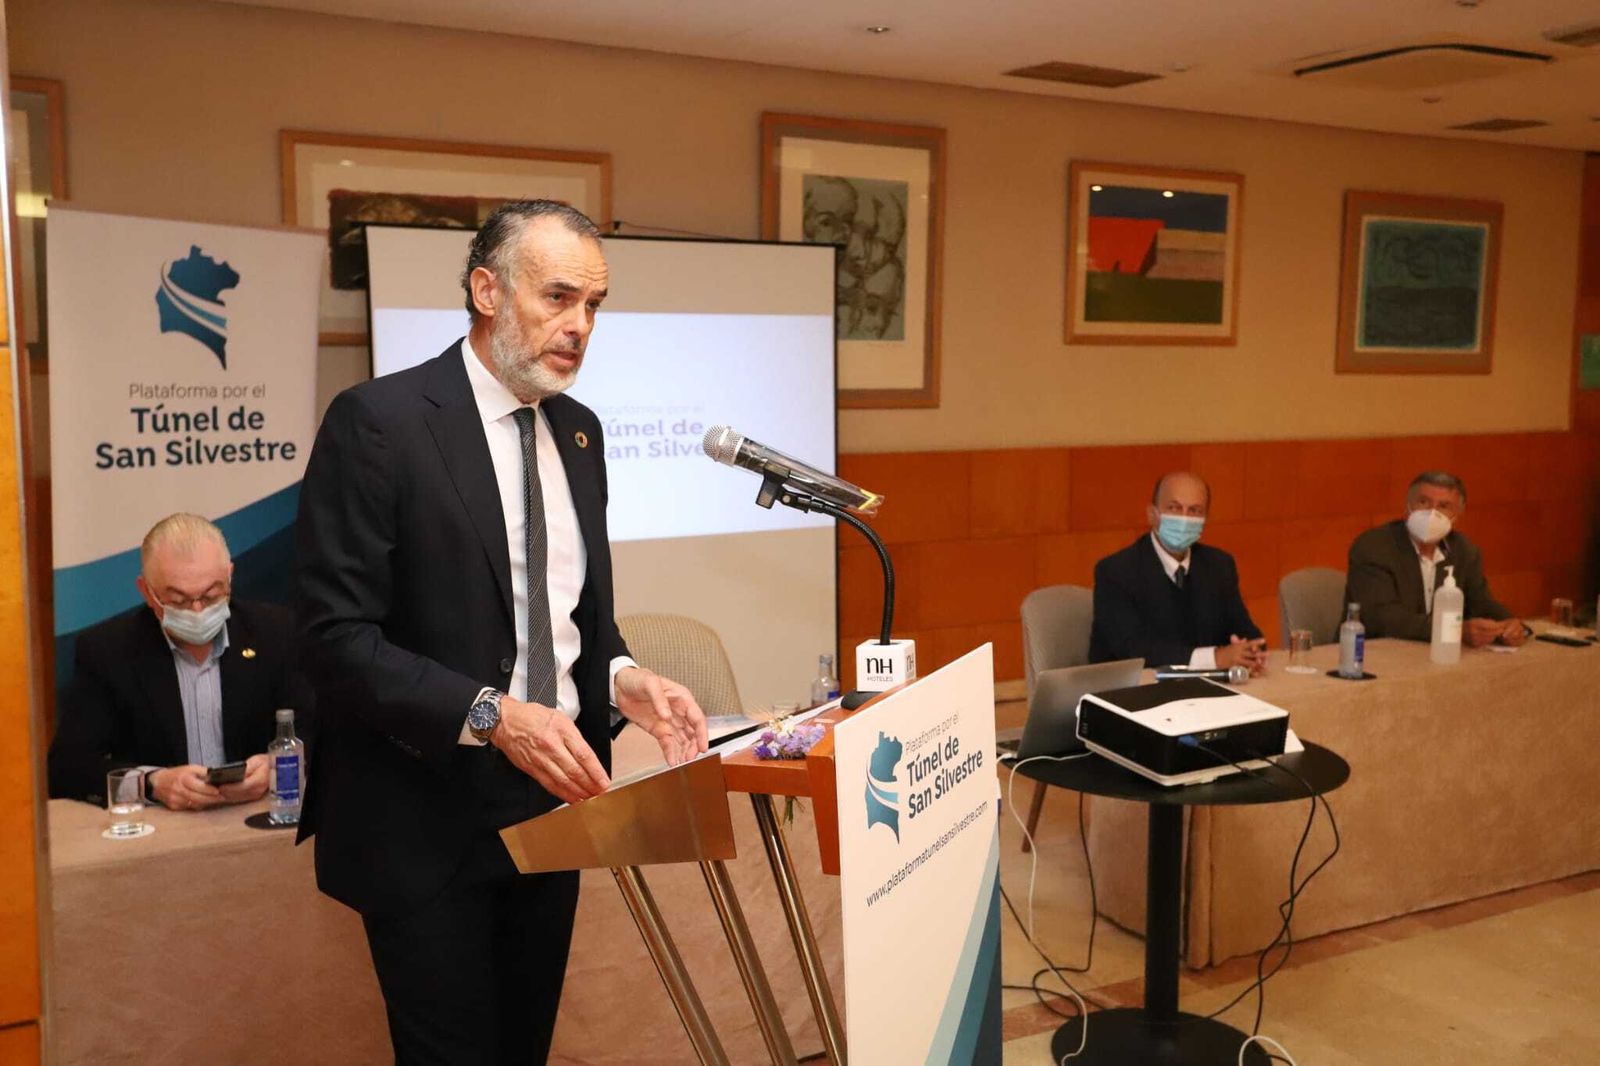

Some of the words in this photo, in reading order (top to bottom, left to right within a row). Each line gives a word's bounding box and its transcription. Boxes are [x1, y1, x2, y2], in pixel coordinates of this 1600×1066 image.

[128, 383, 218, 399] Plataforma
[222, 385, 248, 399] por
[251, 384, 266, 398] el
[130, 403, 219, 433] Túnel
[228, 405, 265, 431] de
[601, 418, 664, 437] únel
[671, 419, 703, 435] de
[95, 443, 156, 469] San
[166, 436, 297, 466] Silvestre
[606, 445, 640, 459] an
[904, 725, 941, 755] Plataforma
[941, 716, 953, 733] por
[906, 742, 942, 787] Túnel
[944, 735, 960, 761] de
[908, 786, 932, 819] San
[935, 750, 983, 800] Silvestre
[866, 801, 988, 907] www.plataformatunelsansilvestre.com
